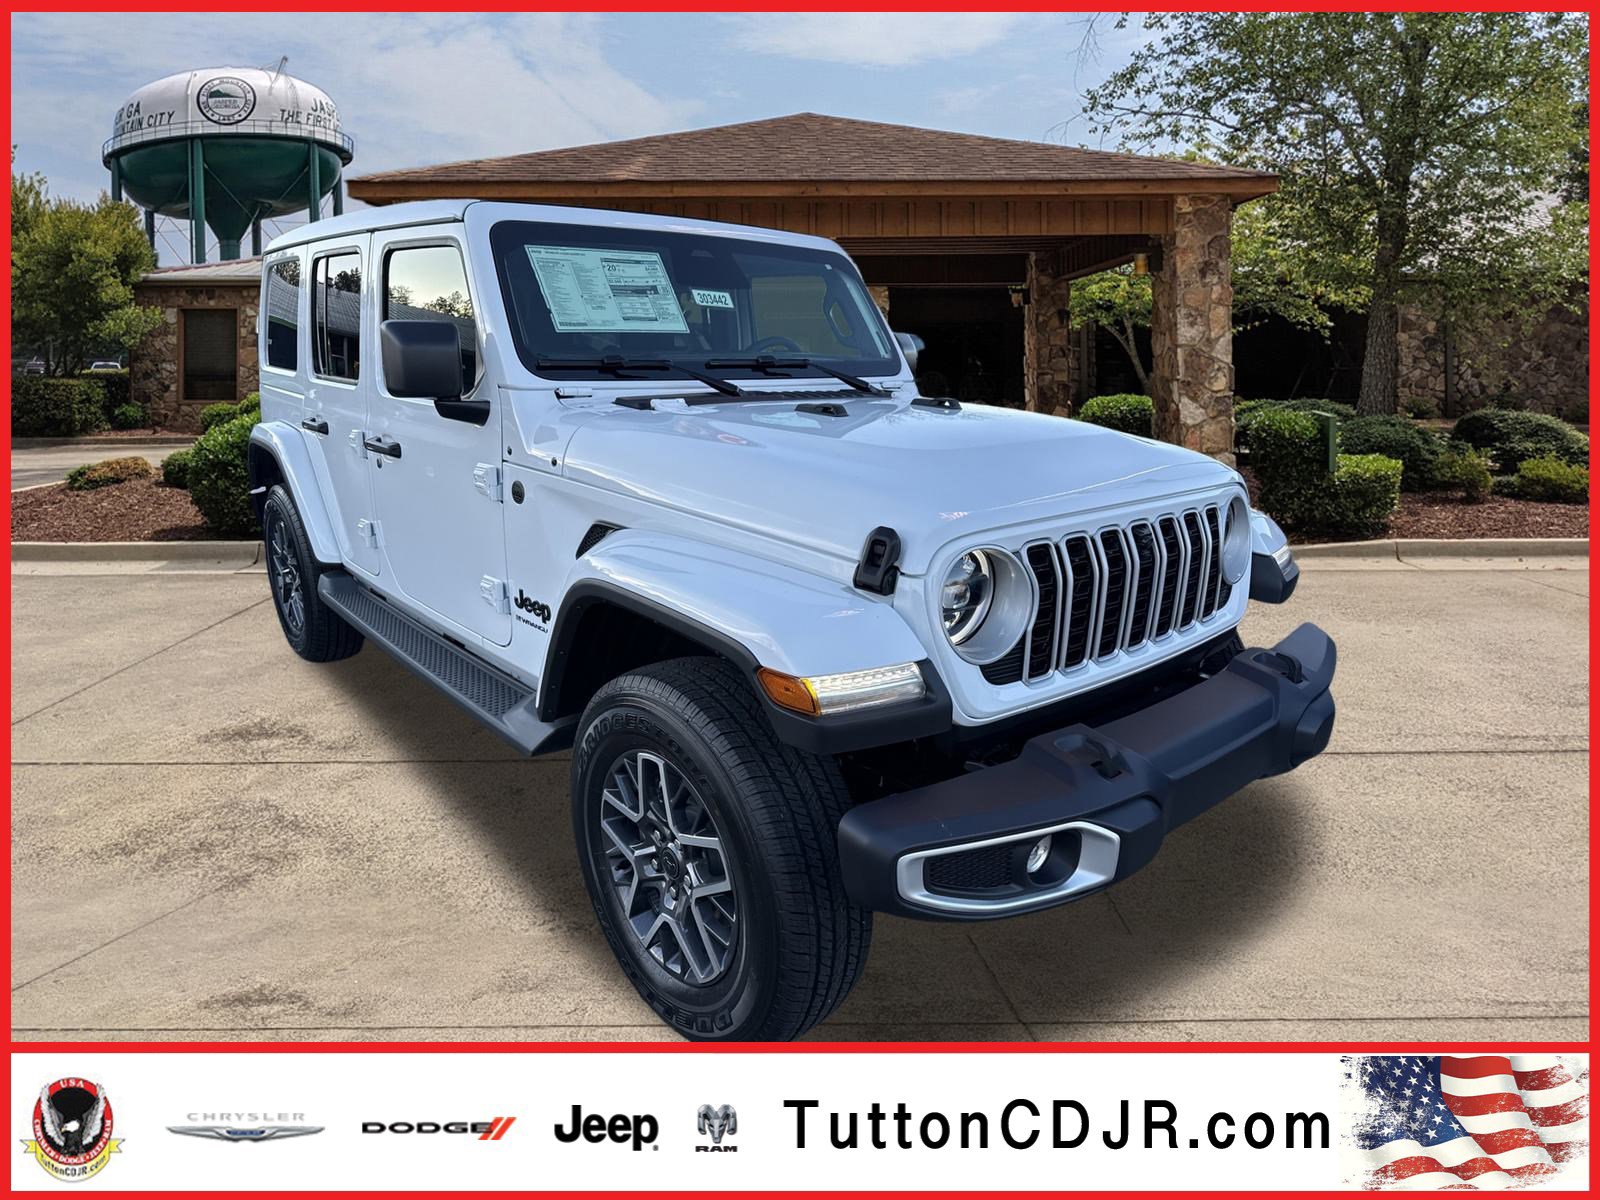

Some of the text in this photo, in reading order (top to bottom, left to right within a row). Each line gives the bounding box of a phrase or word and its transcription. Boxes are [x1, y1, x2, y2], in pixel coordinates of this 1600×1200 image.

[126, 101, 141, 119] GA
[147, 110, 175, 127] CITY
[280, 108, 302, 124] THE
[306, 112, 331, 130] FIRST
[697, 292, 729, 306] 303442
[514, 588, 551, 624] Jeep
